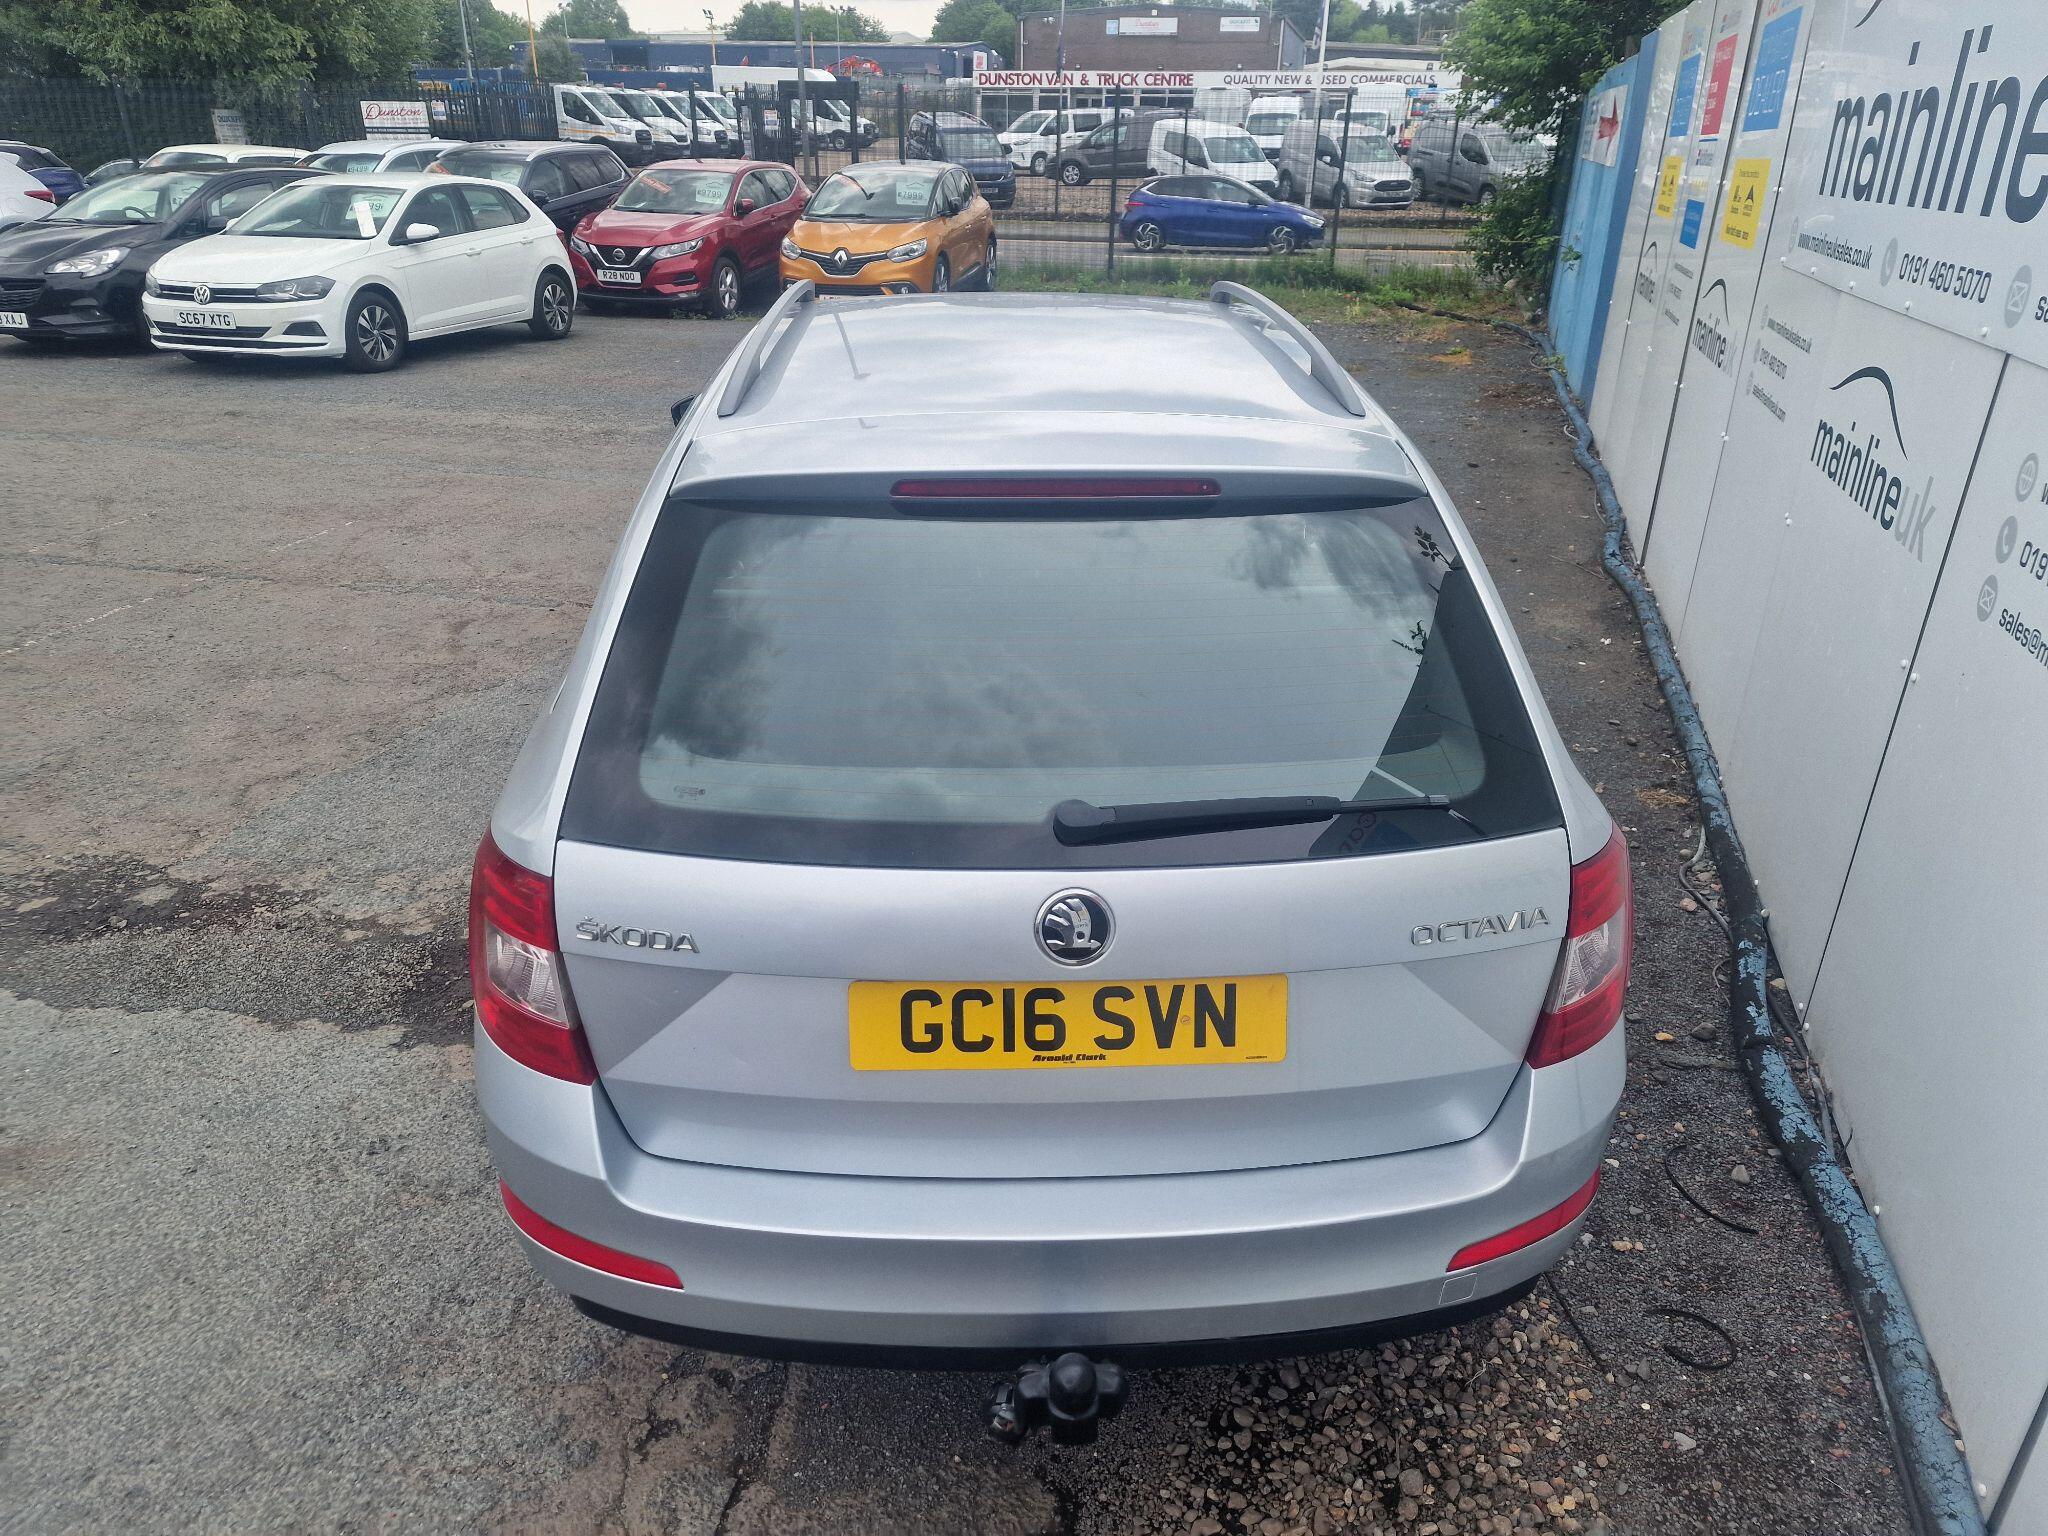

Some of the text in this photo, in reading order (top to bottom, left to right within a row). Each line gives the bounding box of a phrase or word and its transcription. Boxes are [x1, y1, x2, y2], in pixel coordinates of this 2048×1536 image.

[978, 73, 1194, 86] DUNSTON VAN & TRUCK CENTRE
[1223, 74, 1272, 85] QUALITY
[1274, 74, 1302, 85] NEW
[1305, 75, 1312, 85] &
[364, 103, 423, 120] Dunston
[602, 271, 618, 280] R28
[1899, 253, 1992, 304] 0191 460 5070
[180, 312, 231, 326] SC67 XTG
[1811, 418, 1936, 563] mainlineuk
[576, 915, 700, 953] ŠKODA
[1410, 907, 1550, 945] OCTAVIA
[900, 983, 1237, 1053] GC16 SVN
[1032, 1053, 1074, 1062] Arnold
